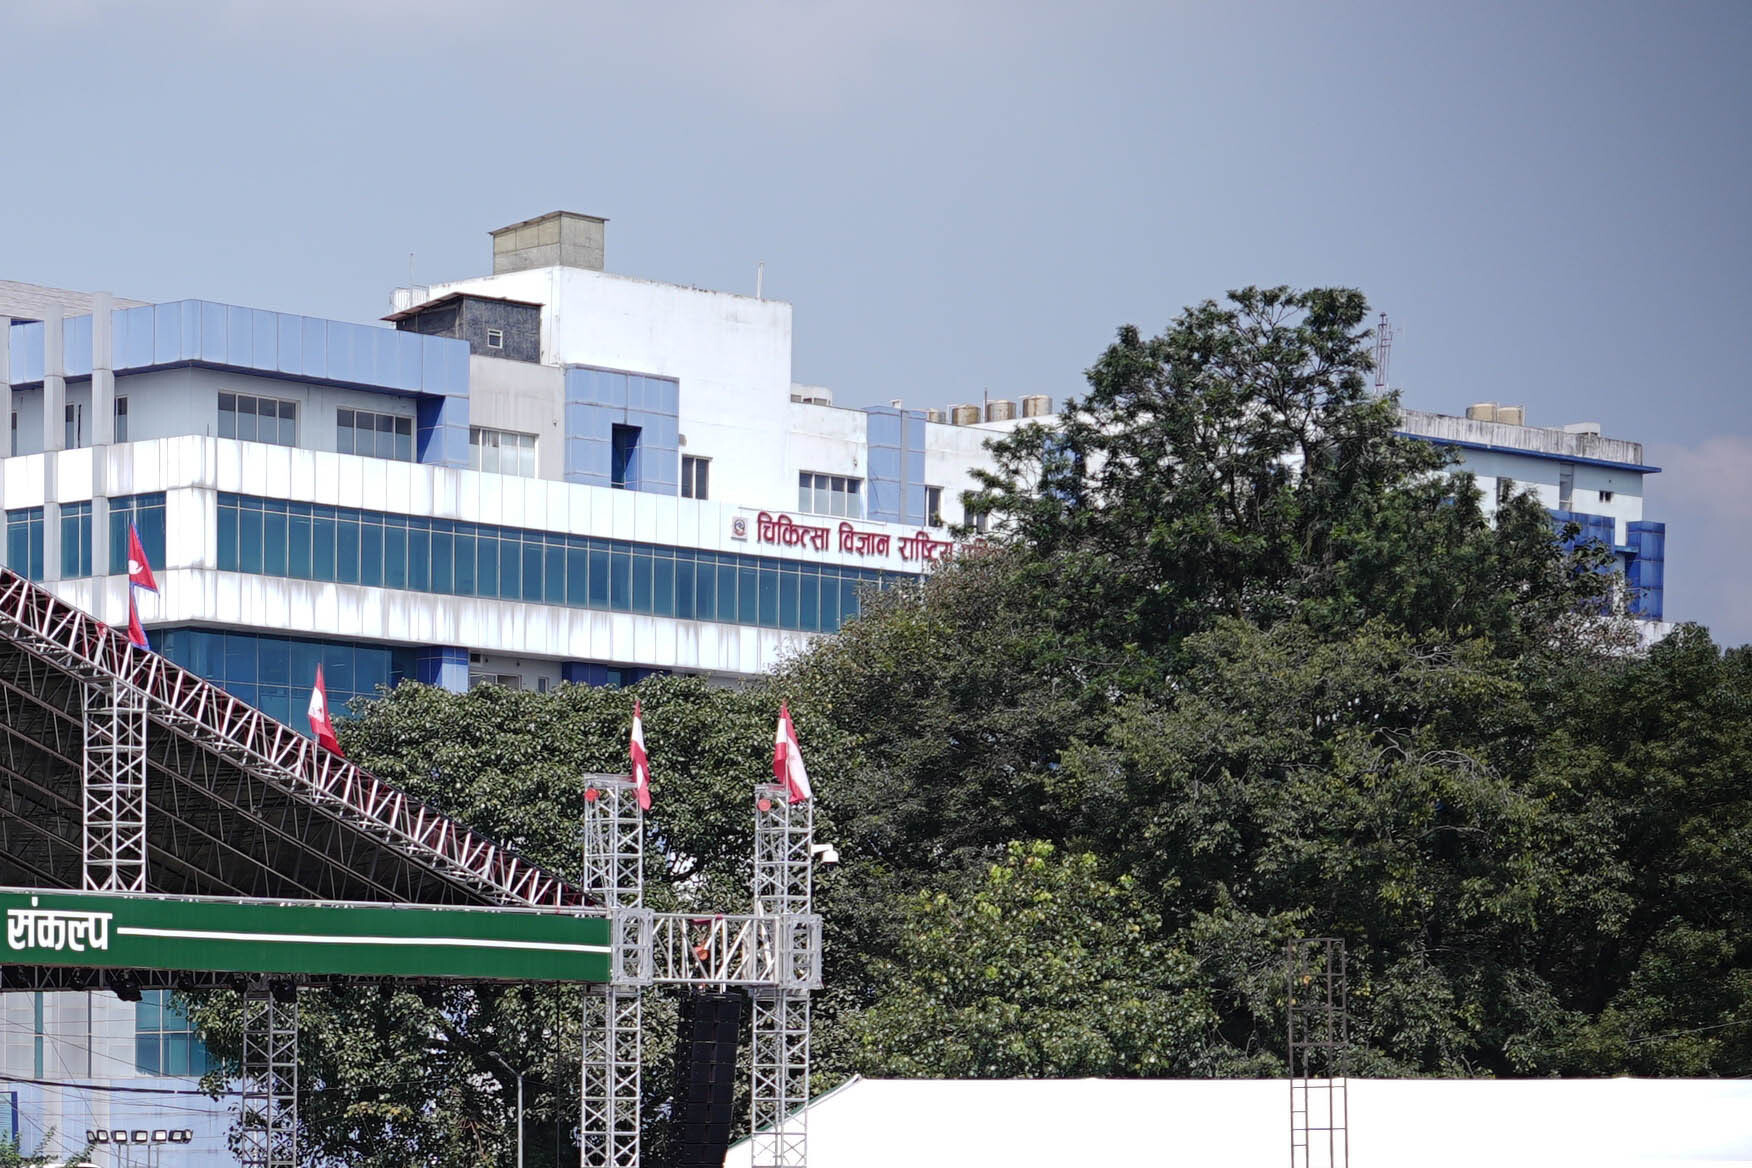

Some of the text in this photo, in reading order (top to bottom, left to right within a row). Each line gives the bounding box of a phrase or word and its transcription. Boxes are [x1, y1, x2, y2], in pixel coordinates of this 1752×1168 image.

[757, 511, 830, 550] चिकित्सा
[839, 521, 890, 557] विज्ञान
[7, 896, 113, 951] संकल्प
